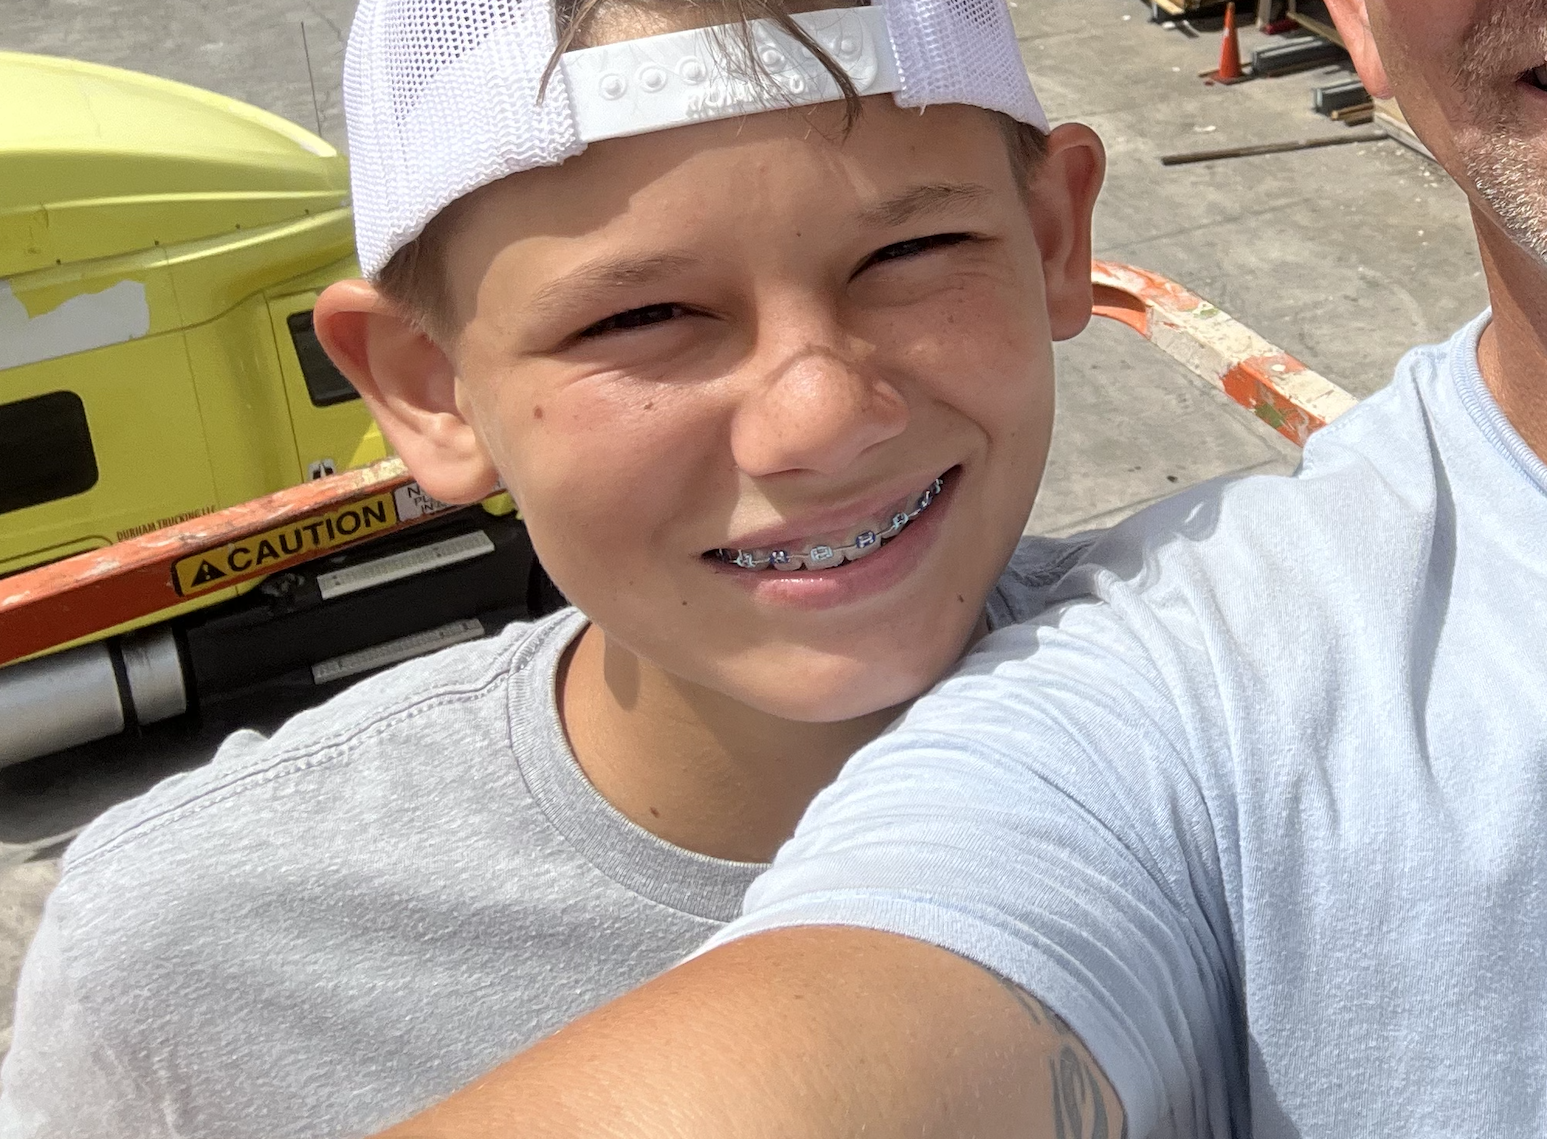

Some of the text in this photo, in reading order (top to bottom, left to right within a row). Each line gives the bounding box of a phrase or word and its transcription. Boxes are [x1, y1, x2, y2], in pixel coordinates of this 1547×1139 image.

[116, 522, 157, 542] DURHAM
[156, 509, 202, 530] TRUCKING
[227, 501, 386, 572] CAUTION
